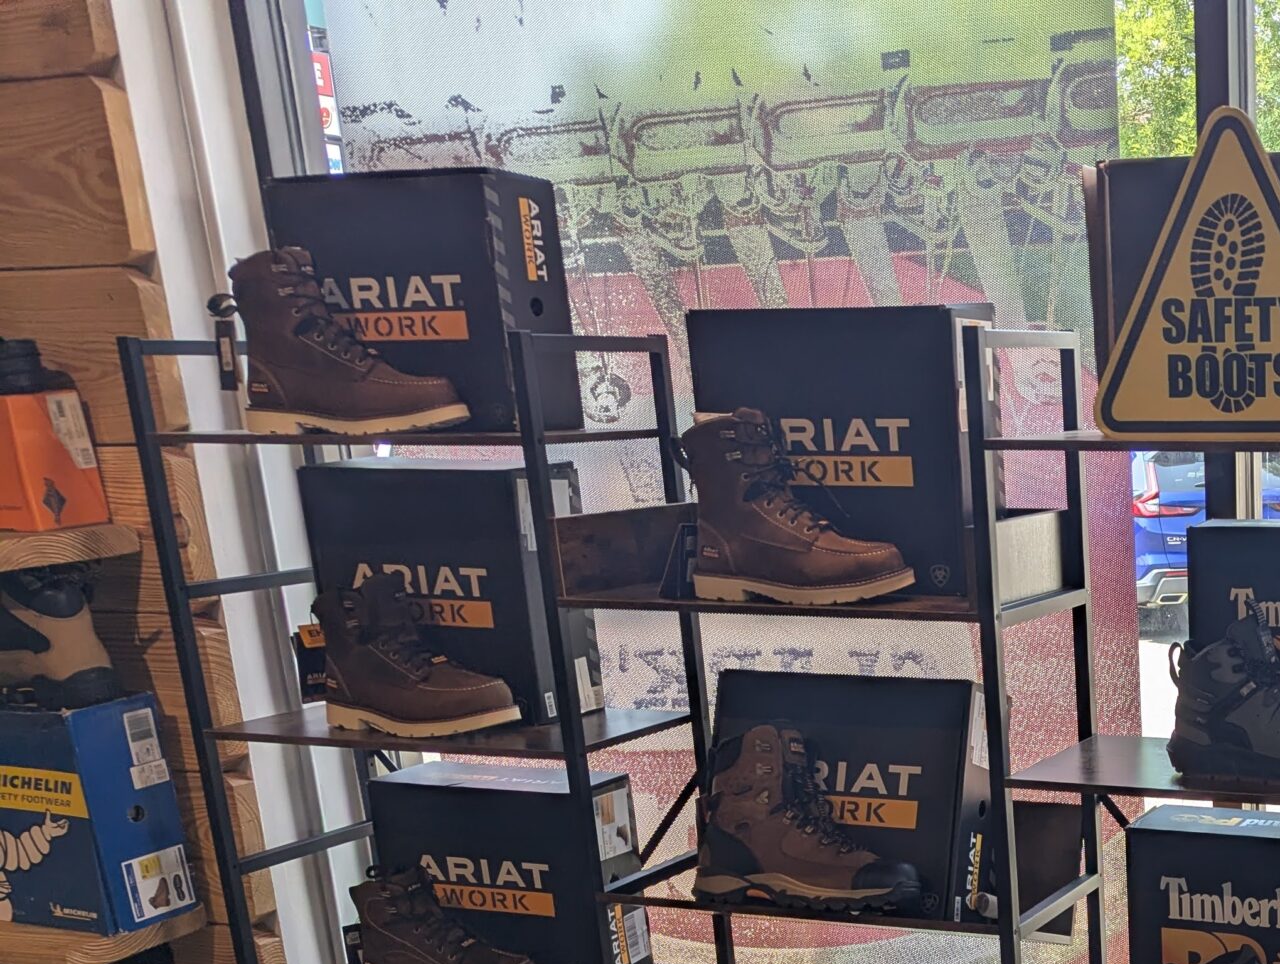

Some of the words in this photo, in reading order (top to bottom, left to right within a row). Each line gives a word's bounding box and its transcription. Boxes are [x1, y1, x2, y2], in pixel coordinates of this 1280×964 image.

[529, 199, 548, 281] ARIAT
[321, 274, 461, 309] ARIAT
[779, 418, 910, 452] RIAT
[411, 602, 469, 624] ORK
[0, 774, 73, 795] ICHELIN
[815, 760, 922, 796] RIAT
[21, 794, 72, 808] FOOTWEAR
[419, 854, 549, 890] ARIAT
[441, 888, 532, 913] WORK
